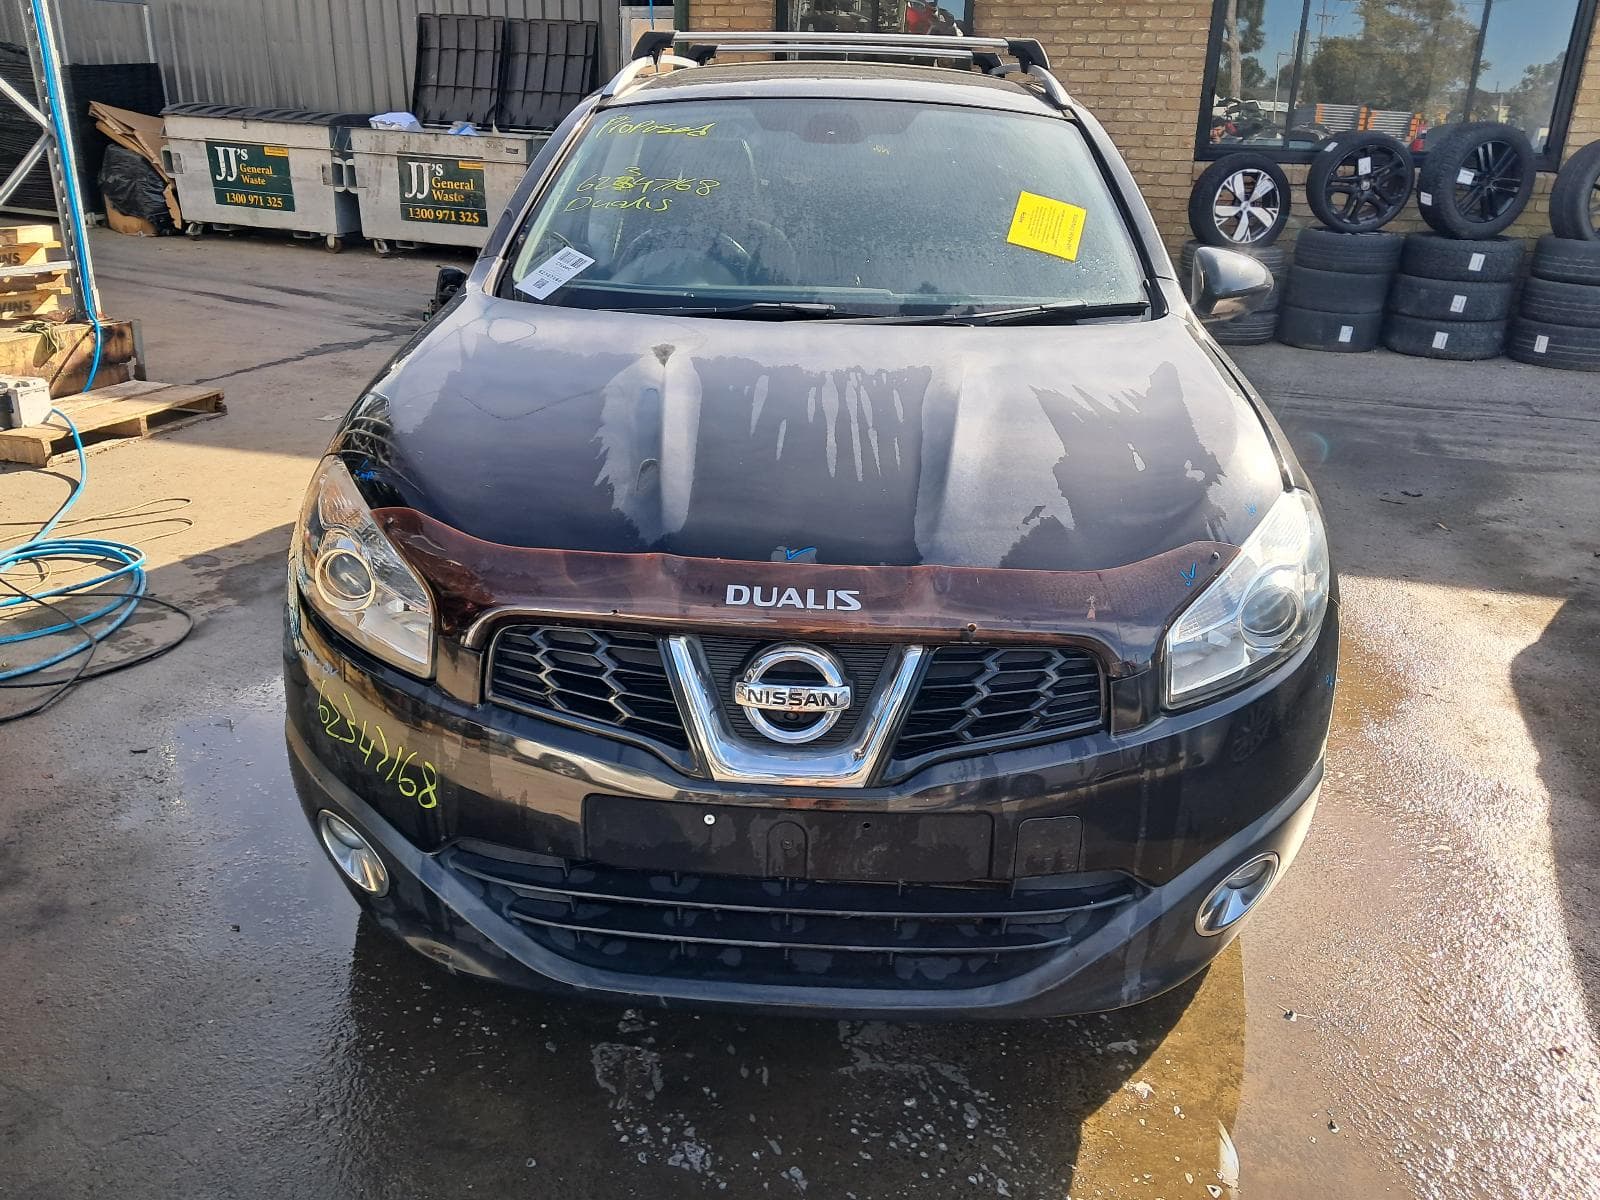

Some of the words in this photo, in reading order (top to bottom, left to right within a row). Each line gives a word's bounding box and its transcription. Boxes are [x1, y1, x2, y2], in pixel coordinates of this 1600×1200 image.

[214, 146, 249, 181] JJ's
[239, 163, 273, 175] General
[241, 174, 266, 185] Waste
[405, 161, 444, 199] JJ's
[431, 176, 475, 191] General
[225, 192, 246, 204] 1300
[248, 195, 264, 206] 971
[266, 196, 283, 208] 325
[431, 188, 465, 202] Waste
[408, 207, 434, 219] 1300
[436, 209, 456, 221] 971
[459, 211, 480, 224] 325
[725, 584, 862, 611] DUALIS
[747, 688, 839, 707] NISSAN
